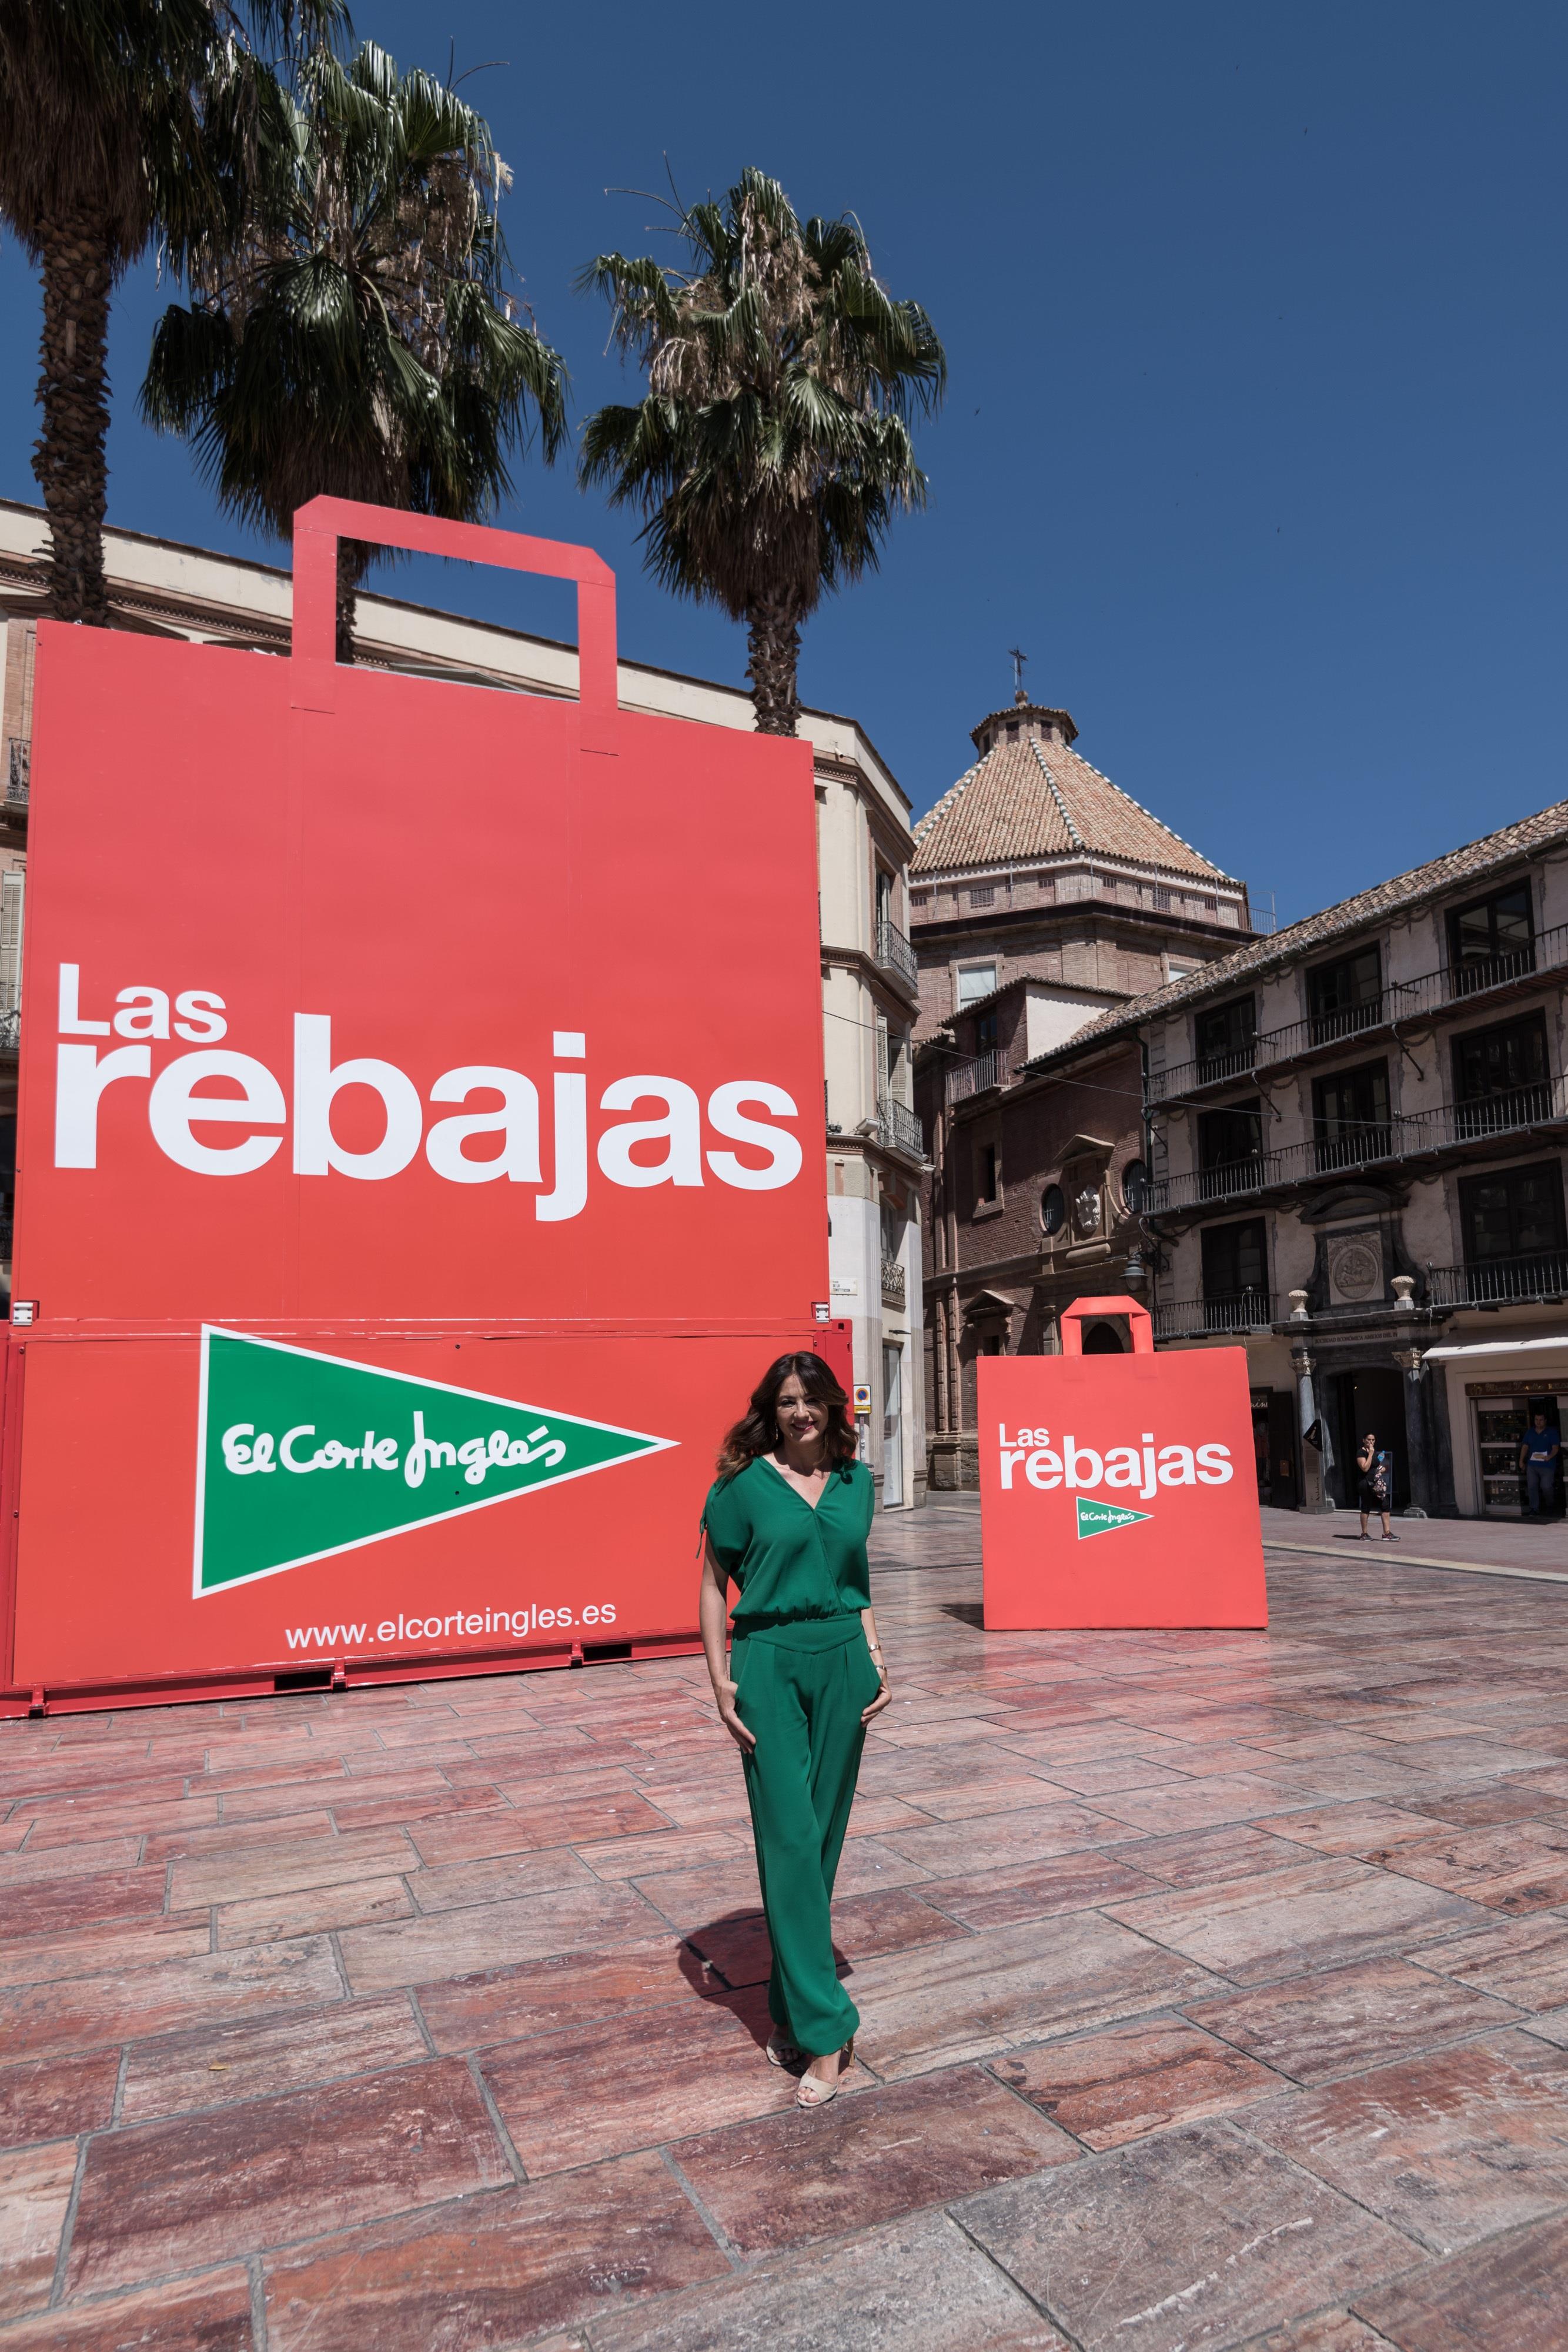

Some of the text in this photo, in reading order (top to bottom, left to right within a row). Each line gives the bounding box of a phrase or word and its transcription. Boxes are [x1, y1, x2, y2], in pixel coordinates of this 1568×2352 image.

[58, 963, 228, 1043] Las
[55, 1012, 803, 1222] rebajas
[222, 1411, 566, 1488] El Corte Inglés
[999, 1423, 1050, 1447] Las
[1000, 1433, 1233, 1499] rebajas
[1080, 1509, 1135, 1524] El Corte Inglés
[285, 1603, 616, 1649] www.elcorteingles.es
